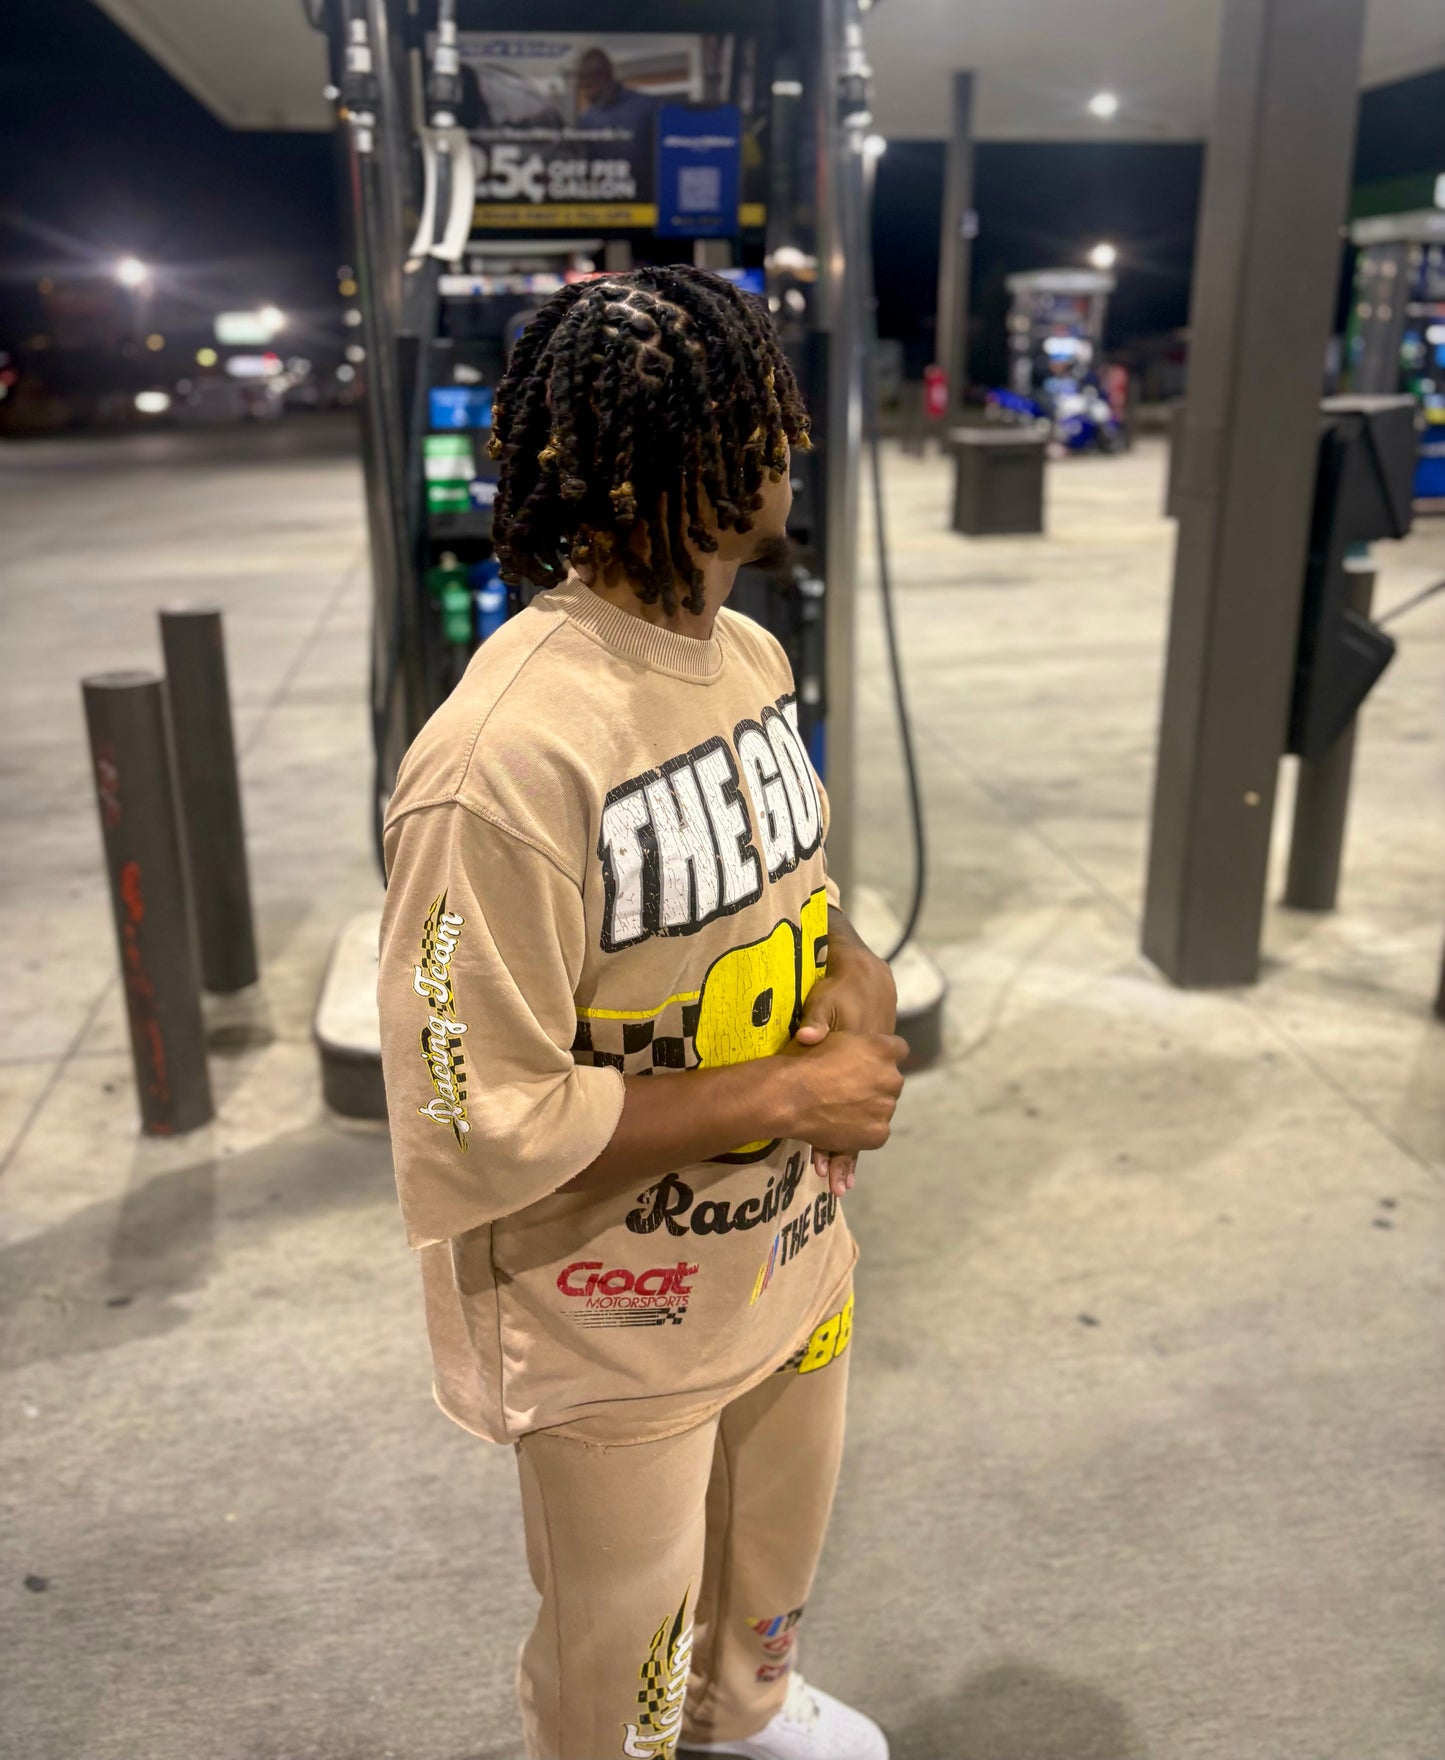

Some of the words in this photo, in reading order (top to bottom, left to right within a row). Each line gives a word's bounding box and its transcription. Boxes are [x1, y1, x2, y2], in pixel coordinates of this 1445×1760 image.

[597, 735, 764, 953] THE
[412, 910, 465, 1005] Team
[417, 1014, 472, 1134] Racing
[780, 1202, 812, 1267] THE
[556, 1261, 699, 1297] Goat
[585, 1295, 690, 1309] MOTORSPORTS
